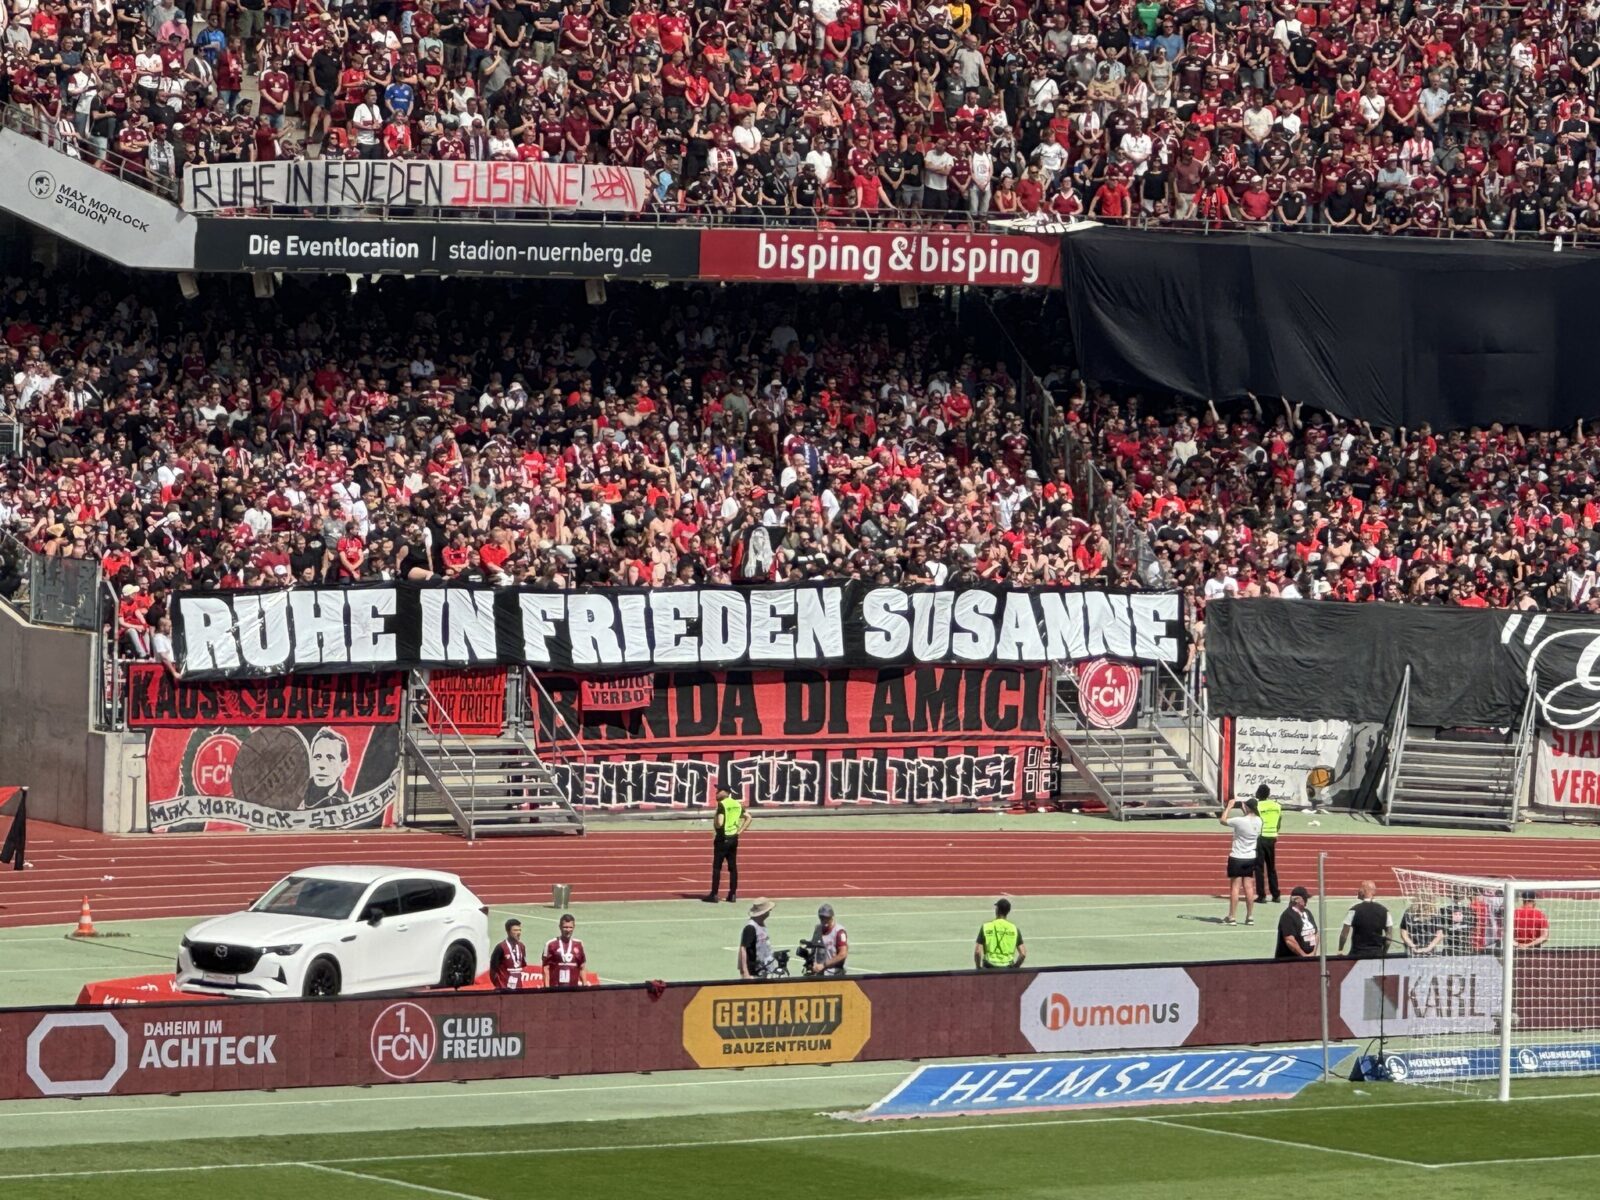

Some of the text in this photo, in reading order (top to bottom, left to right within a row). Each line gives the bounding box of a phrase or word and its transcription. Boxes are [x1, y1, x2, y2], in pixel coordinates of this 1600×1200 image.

[192, 164, 282, 209] RUHE
[285, 162, 313, 206] IN
[324, 161, 443, 206] FRIEDEN
[55, 194, 108, 225] STADION
[59, 184, 150, 233] MAX MORLOCK
[249, 234, 419, 259] Die Eventlocation
[449, 239, 652, 268] stadion-nuernberg.de
[758, 232, 881, 280] bisping
[920, 236, 1040, 284] bisping
[179, 586, 1179, 671] RUHE IN FRIEDEN SUSANNE
[1105, 667, 1118, 685] 1.
[460, 692, 502, 722] PROFIT
[784, 670, 850, 736] DI
[870, 666, 1045, 733] AMICI
[1091, 685, 1126, 708] FCN
[1552, 729, 1600, 758] STA
[728, 750, 821, 805] FÜR
[1551, 769, 1600, 806] VER
[150, 801, 193, 822] MAX
[1040, 992, 1180, 1031] humanus
[1402, 973, 1485, 1020] KARL
[395, 1007, 411, 1033] 1.
[442, 1017, 493, 1038] CLUB
[715, 997, 840, 1028] GEBHARDT
[144, 1020, 223, 1037] DAHEIM IM
[138, 1035, 278, 1069] ACHTECK
[377, 1033, 428, 1062] FCN
[442, 1036, 521, 1059] FREUND
[722, 1039, 832, 1055] BAUZENTRUM
[929, 1054, 1297, 1107] HELMSAUER
